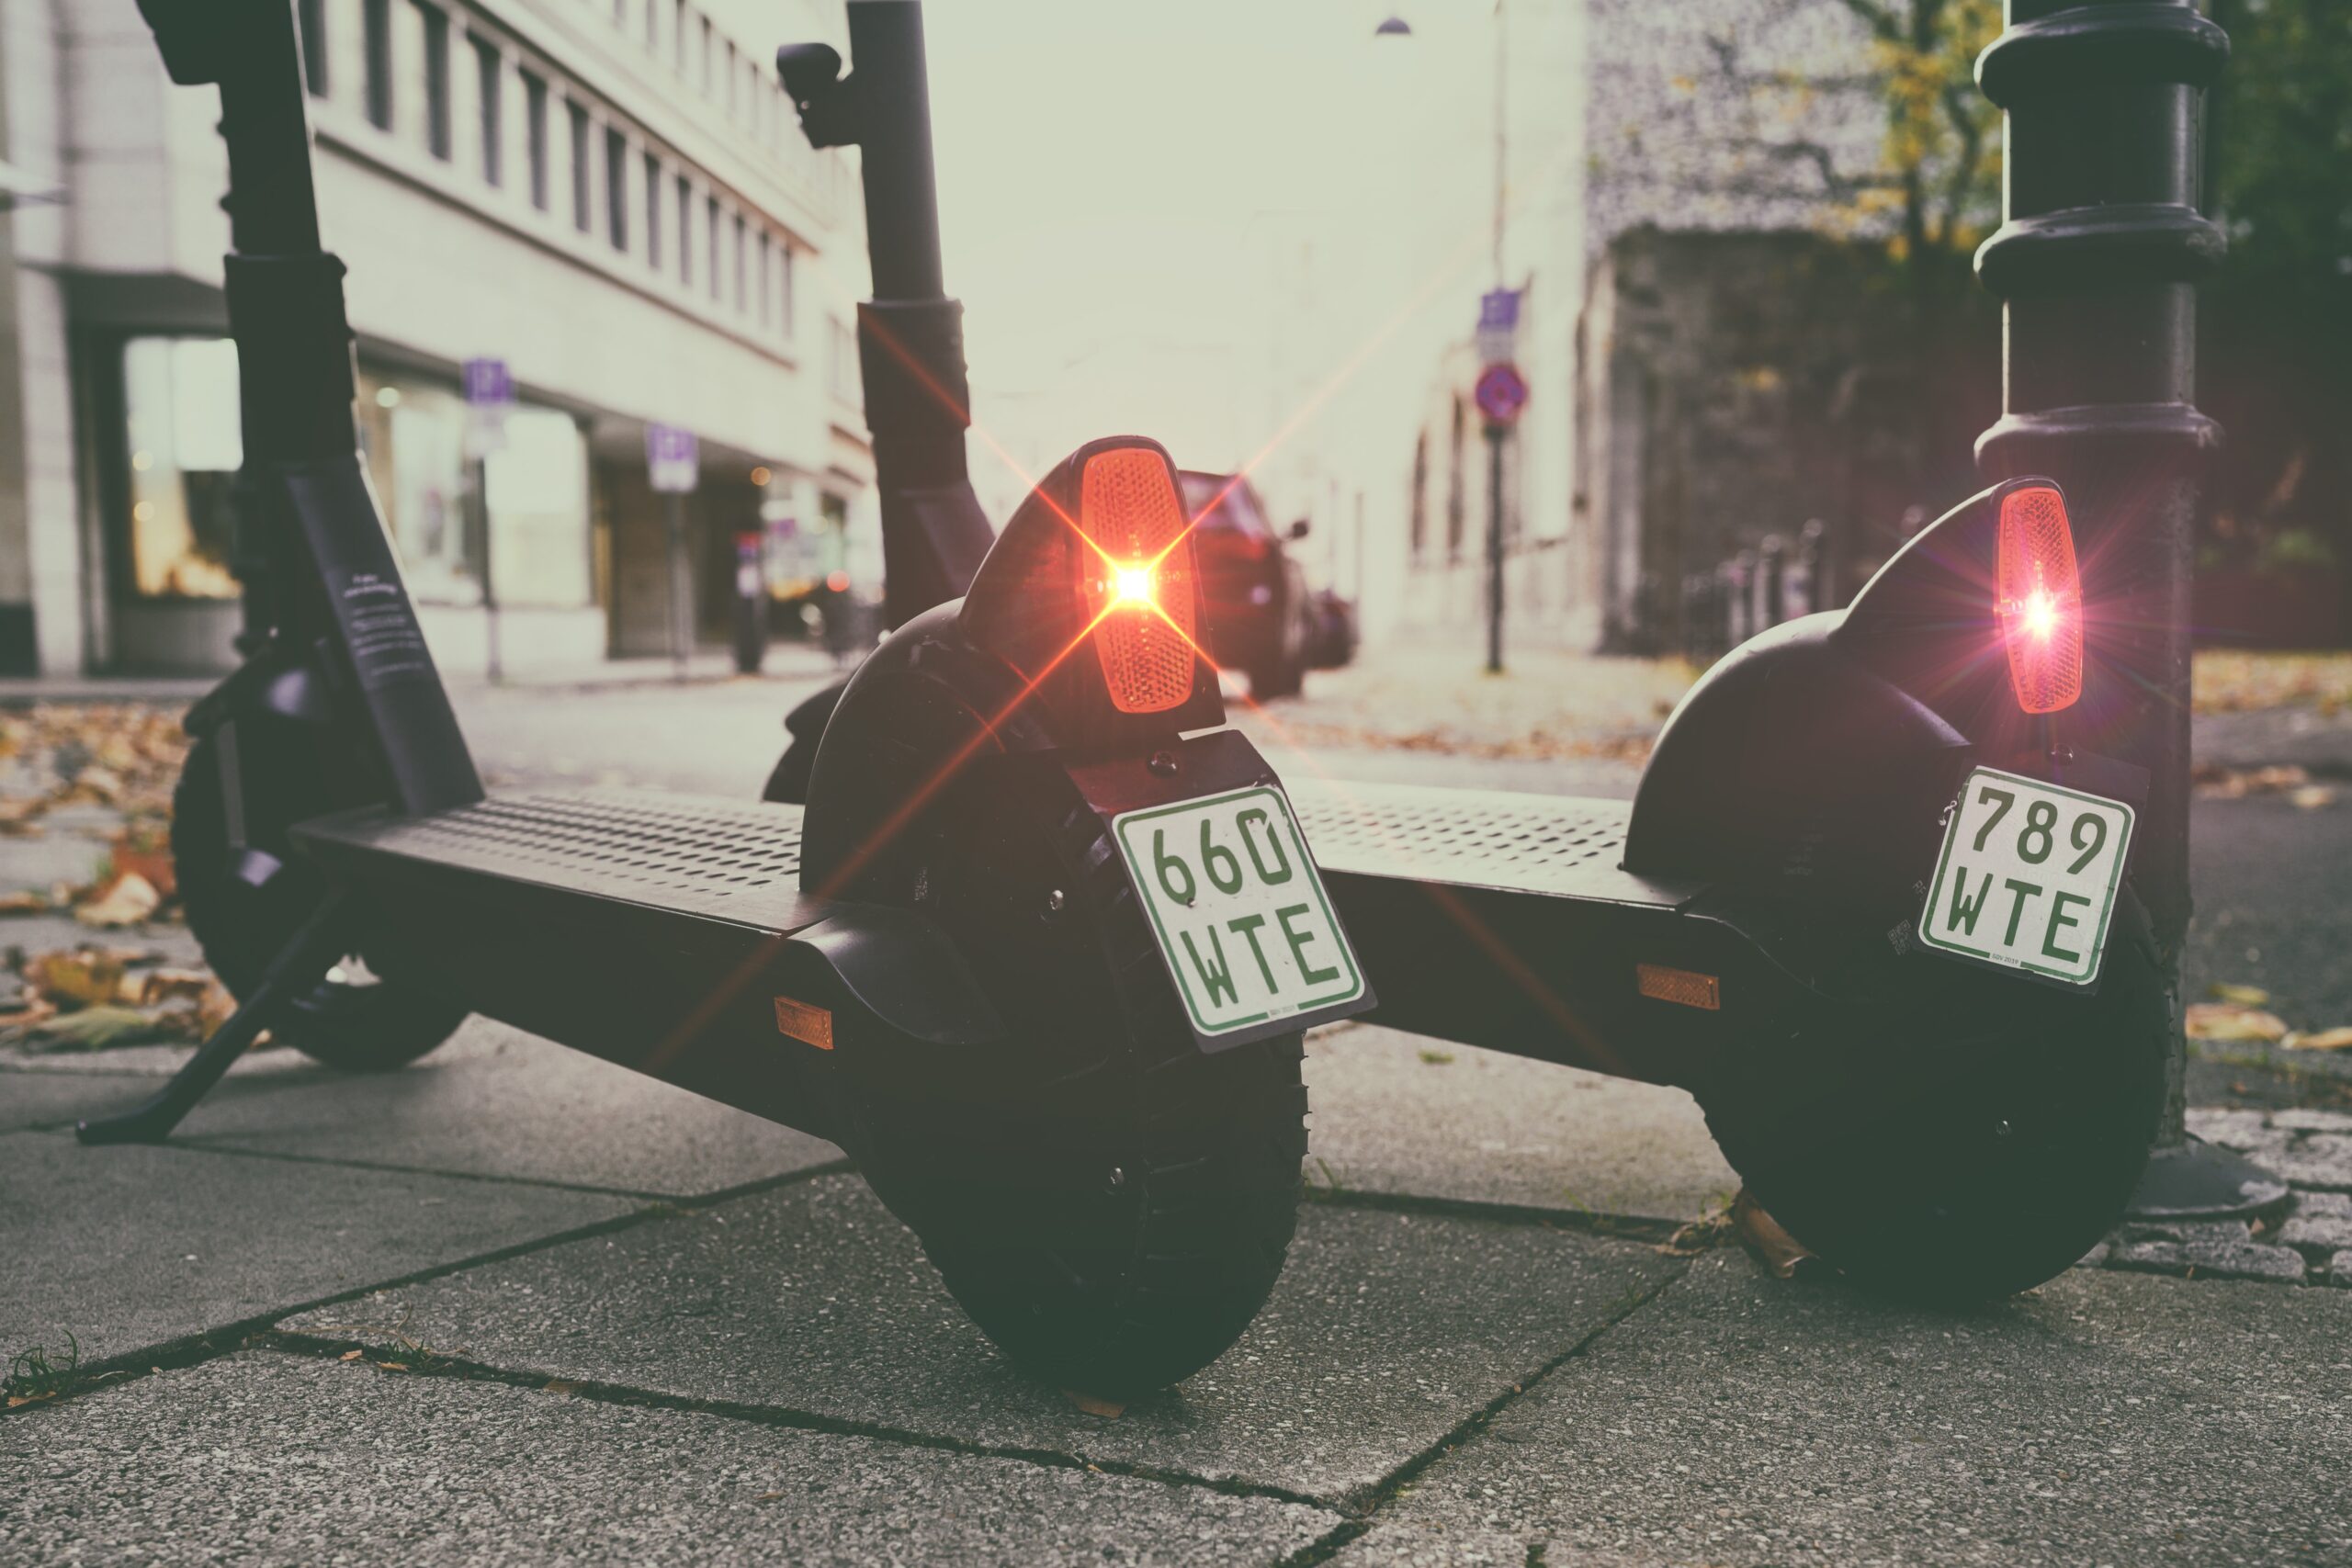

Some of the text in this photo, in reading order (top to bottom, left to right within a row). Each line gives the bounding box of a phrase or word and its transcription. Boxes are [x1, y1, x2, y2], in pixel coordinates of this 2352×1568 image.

[1153, 807, 1293, 907] 660
[1973, 786, 2108, 875] 789
[1180, 903, 1340, 1009] WTE
[1947, 865, 2091, 964] WTE
